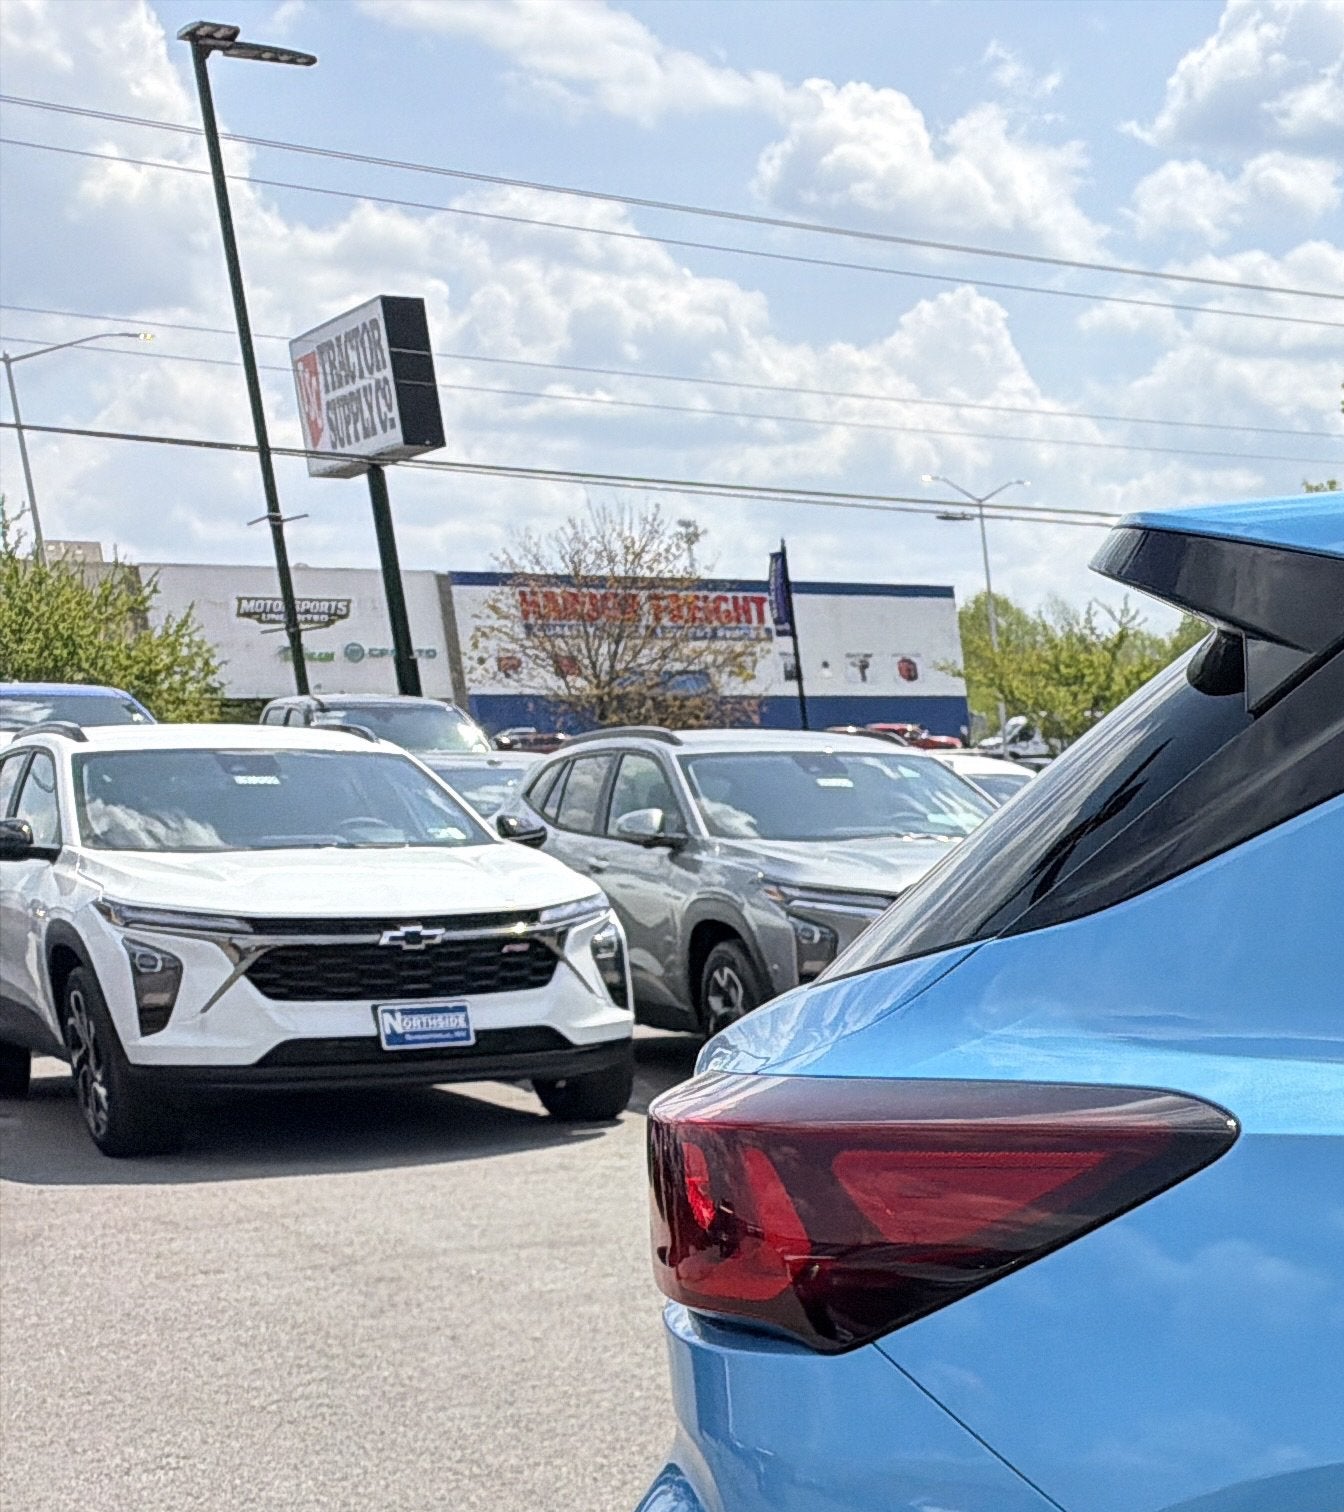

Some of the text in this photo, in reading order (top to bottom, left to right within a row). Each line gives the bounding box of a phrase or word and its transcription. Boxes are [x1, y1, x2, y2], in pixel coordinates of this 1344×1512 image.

[316, 317, 387, 394] TRACTOR
[326, 382, 378, 450] SUPPLY
[240, 600, 348, 616] MOTOSPORTS
